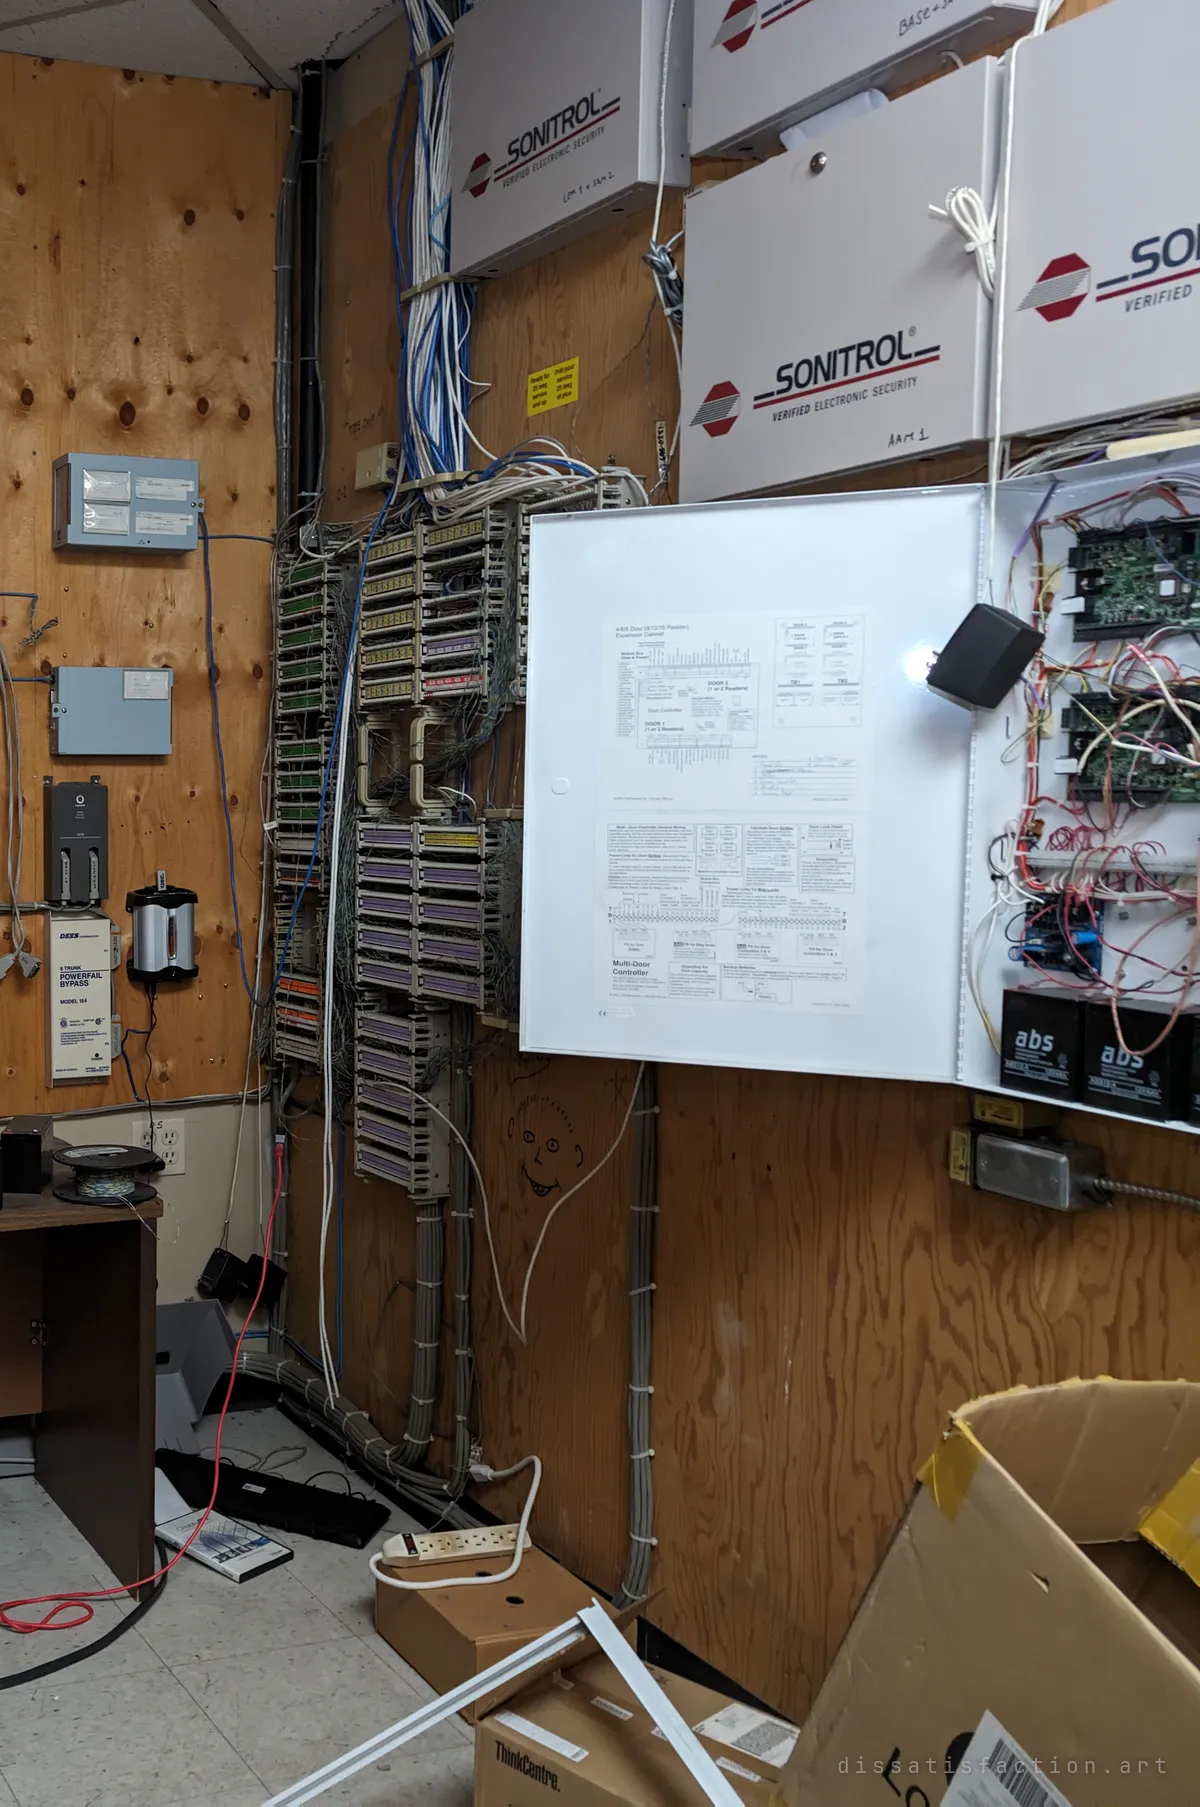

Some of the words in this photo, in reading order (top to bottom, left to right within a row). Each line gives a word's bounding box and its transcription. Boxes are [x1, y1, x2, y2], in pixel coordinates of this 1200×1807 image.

[507, 91, 600, 166] SONITROL
[503, 168, 531, 189] VERIFIED
[532, 145, 571, 174] ELECTRONIC
[573, 125, 606, 150] SECURITY
[1130, 223, 1200, 280] SO
[1124, 283, 1194, 313] VERIFIED
[775, 330, 913, 396] SONITROL
[772, 404, 811, 422] VERIFIED
[814, 388, 869, 412] ELECTRONIC
[872, 376, 918, 398] SECURITY
[59, 932, 80, 940] DEES
[59, 971, 103, 981] POWERFAIL
[612, 959, 651, 969] Multi-Door
[612, 968, 649, 977] Controller
[59, 980, 89, 988] BYPASS
[1015, 1028, 1054, 1053] abs
[1101, 1045, 1145, 1069] abs
